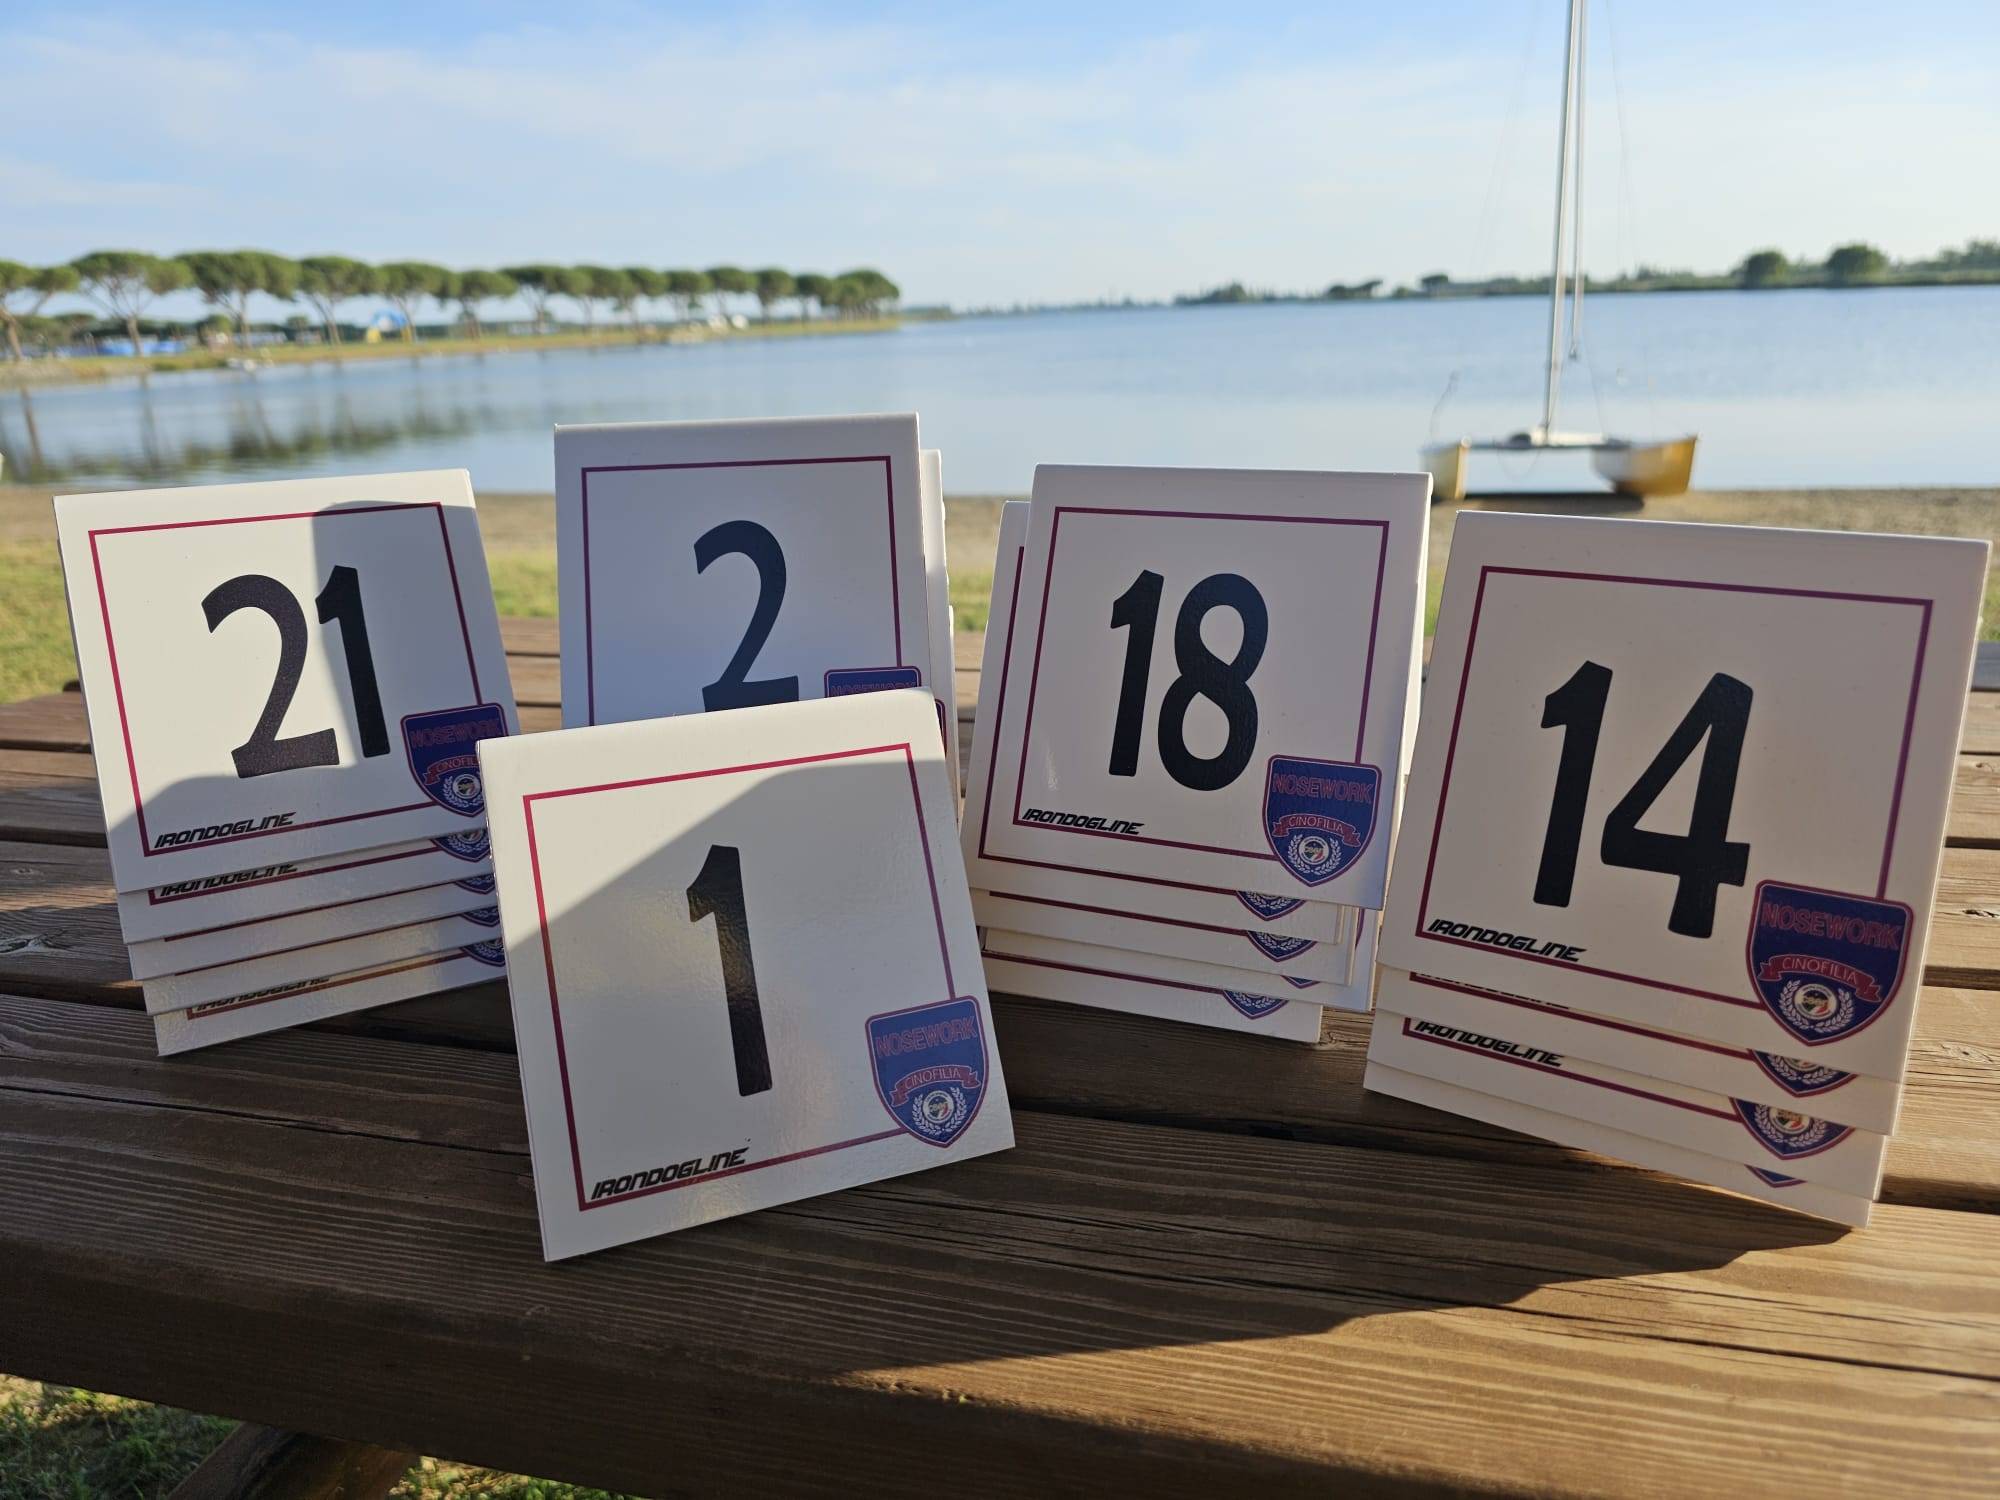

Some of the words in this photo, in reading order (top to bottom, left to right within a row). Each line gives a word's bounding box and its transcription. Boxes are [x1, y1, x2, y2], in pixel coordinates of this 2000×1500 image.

[693, 519, 800, 710] 2
[201, 564, 390, 779] 21
[1109, 569, 1269, 792] 18
[409, 718, 500, 749] NOSEWORK
[1272, 772, 1375, 804] NOSEWORK
[1532, 660, 1753, 939] 14
[154, 811, 297, 848] IRONDOGLINE
[1021, 808, 1145, 835] IRONDOGLINE
[1288, 815, 1344, 833] CINOFILIA
[1427, 918, 1588, 962] IRONDOGLINE
[1760, 901, 1901, 949] NOSEWORK
[685, 844, 773, 1098] 1
[1782, 957, 1858, 984] CINOFILIA
[875, 1015, 978, 1058] NOSEWORK
[1413, 1020, 1567, 1068] IRONDOGLINE
[904, 1067, 962, 1090] CINOFILIA
[590, 1146, 750, 1200] IRONDOGLINE
